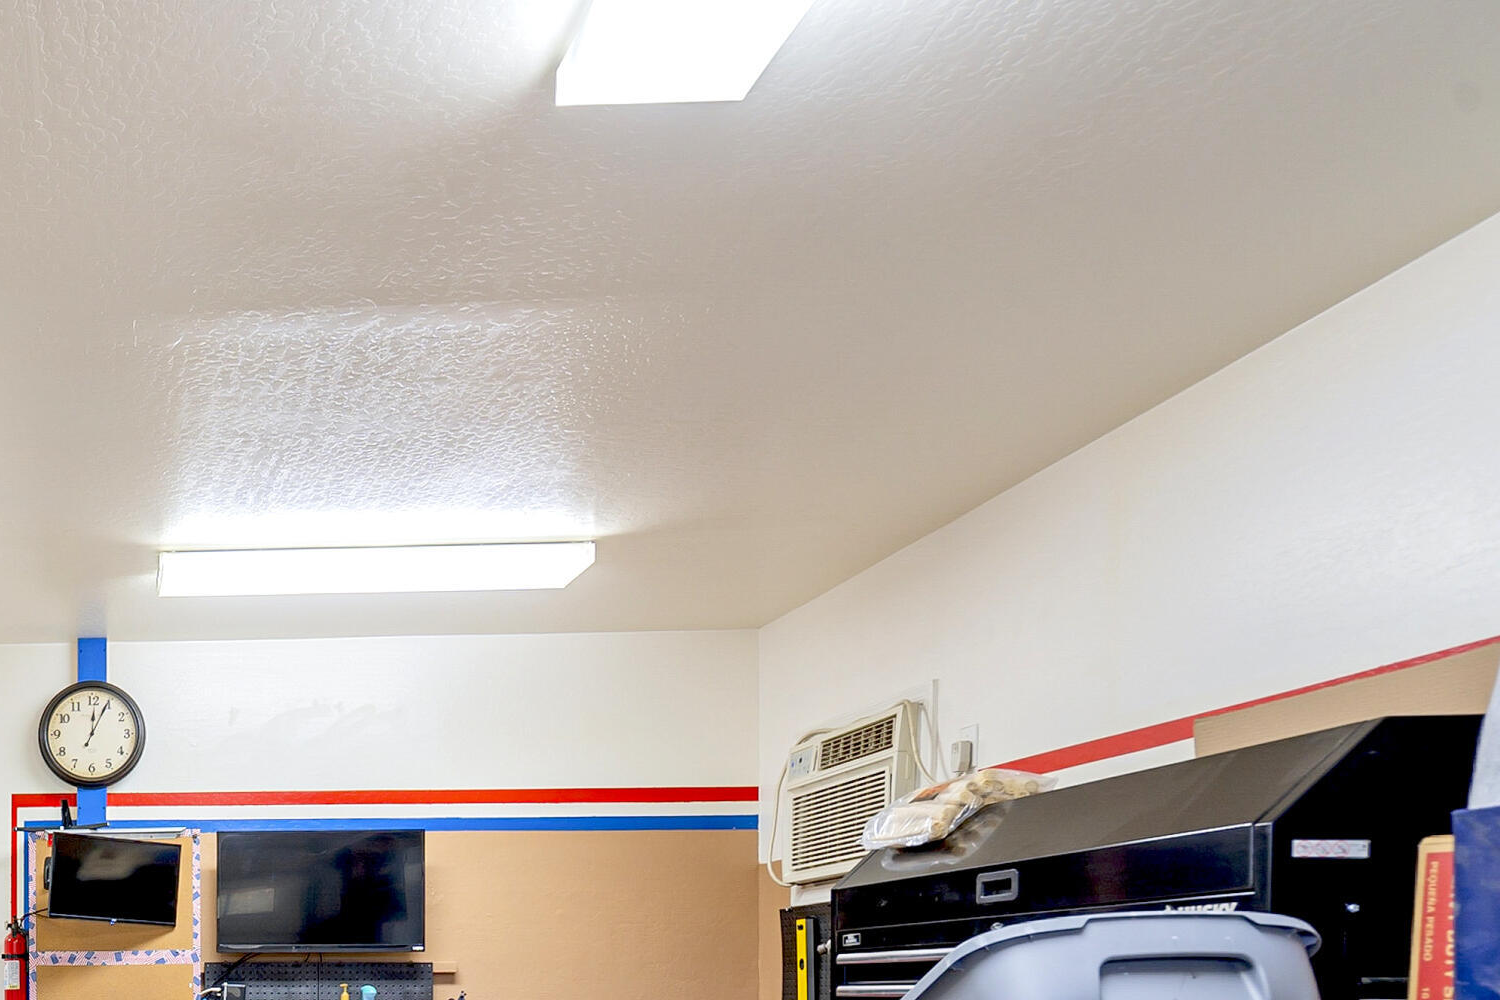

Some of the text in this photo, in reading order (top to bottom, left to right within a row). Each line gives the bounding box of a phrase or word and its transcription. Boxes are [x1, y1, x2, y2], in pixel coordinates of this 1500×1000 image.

[88, 696, 100, 706] 12
[71, 702, 81, 711] 11
[60, 713, 70, 723] 10
[118, 712, 125, 722] 2
[53, 729, 61, 739] 9
[123, 729, 130, 739] 3
[58, 747, 66, 756] 8
[117, 746, 124, 755] 4
[71, 758, 78, 768] 7
[88, 763, 96, 772] 6
[105, 758, 112, 768] 5
